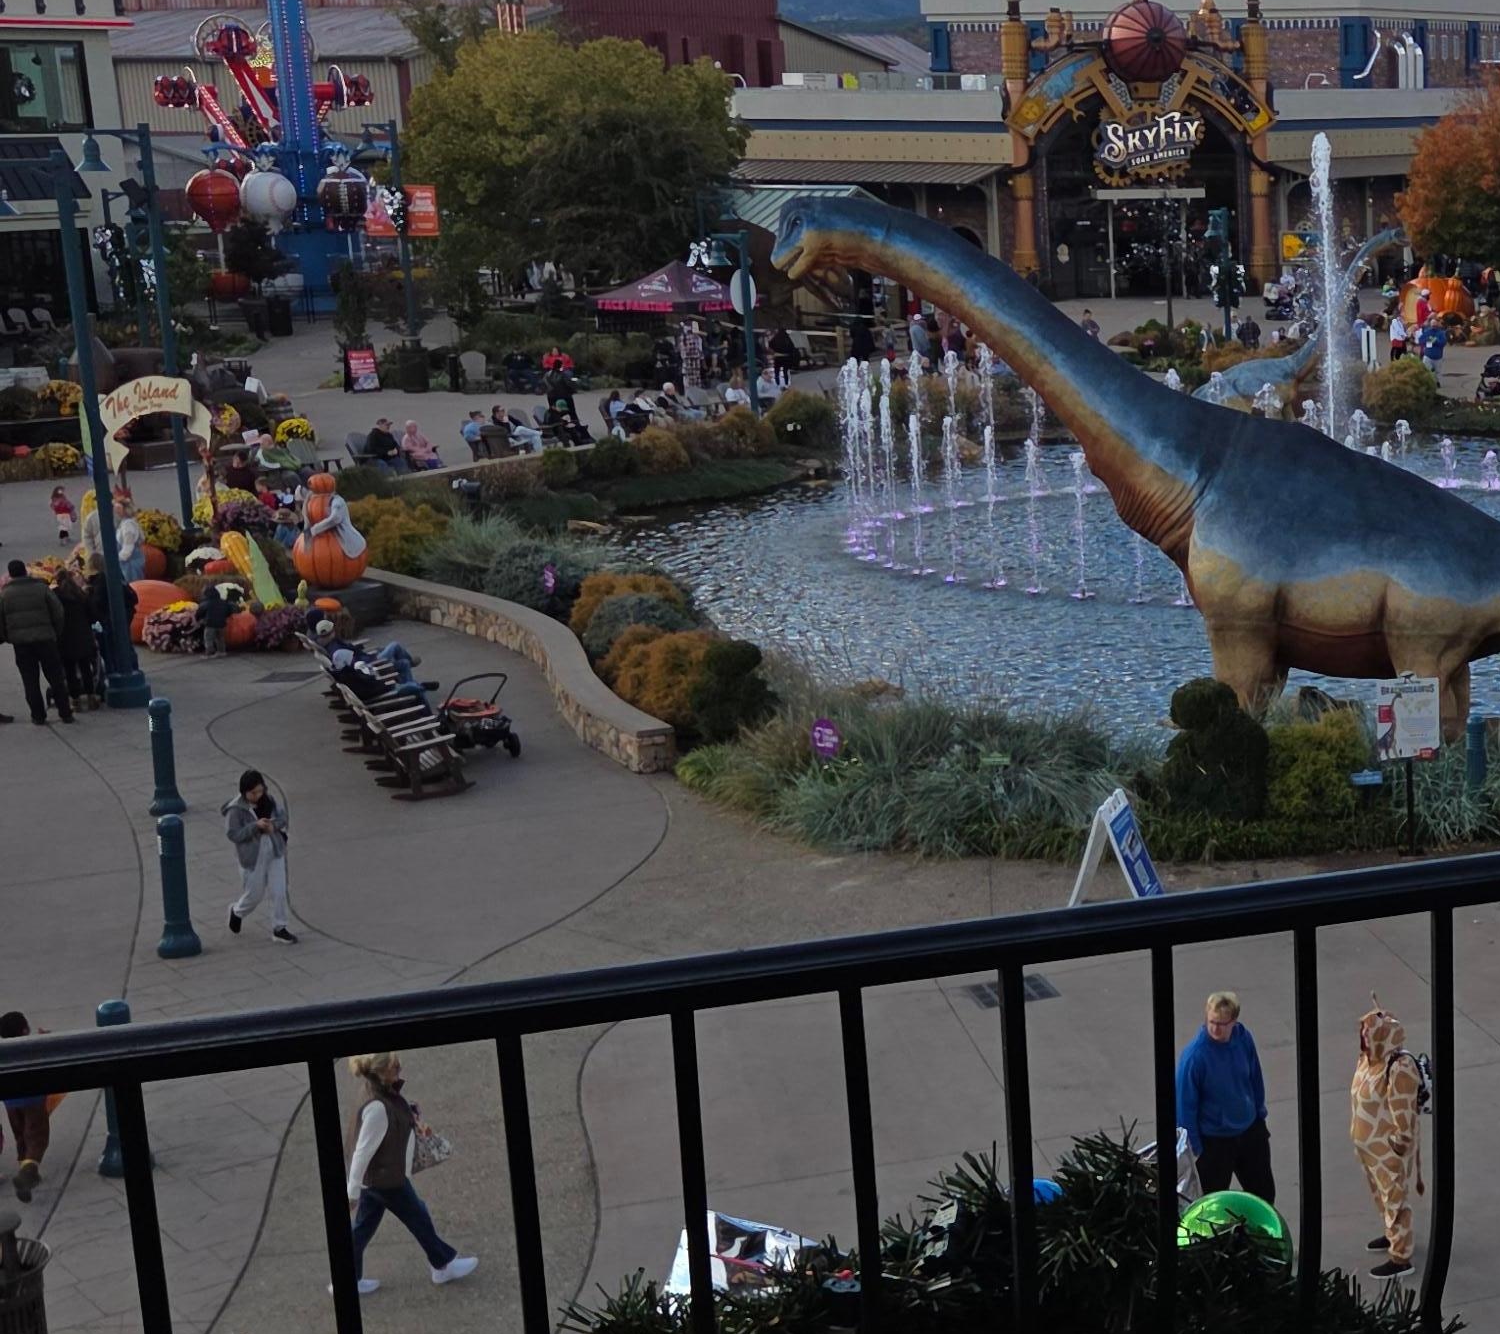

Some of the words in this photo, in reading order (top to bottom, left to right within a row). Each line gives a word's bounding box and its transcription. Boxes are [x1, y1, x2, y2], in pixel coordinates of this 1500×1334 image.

[1154, 148, 1185, 160] AMERICA
[105, 393, 129, 419] The
[133, 381, 179, 402] Island
